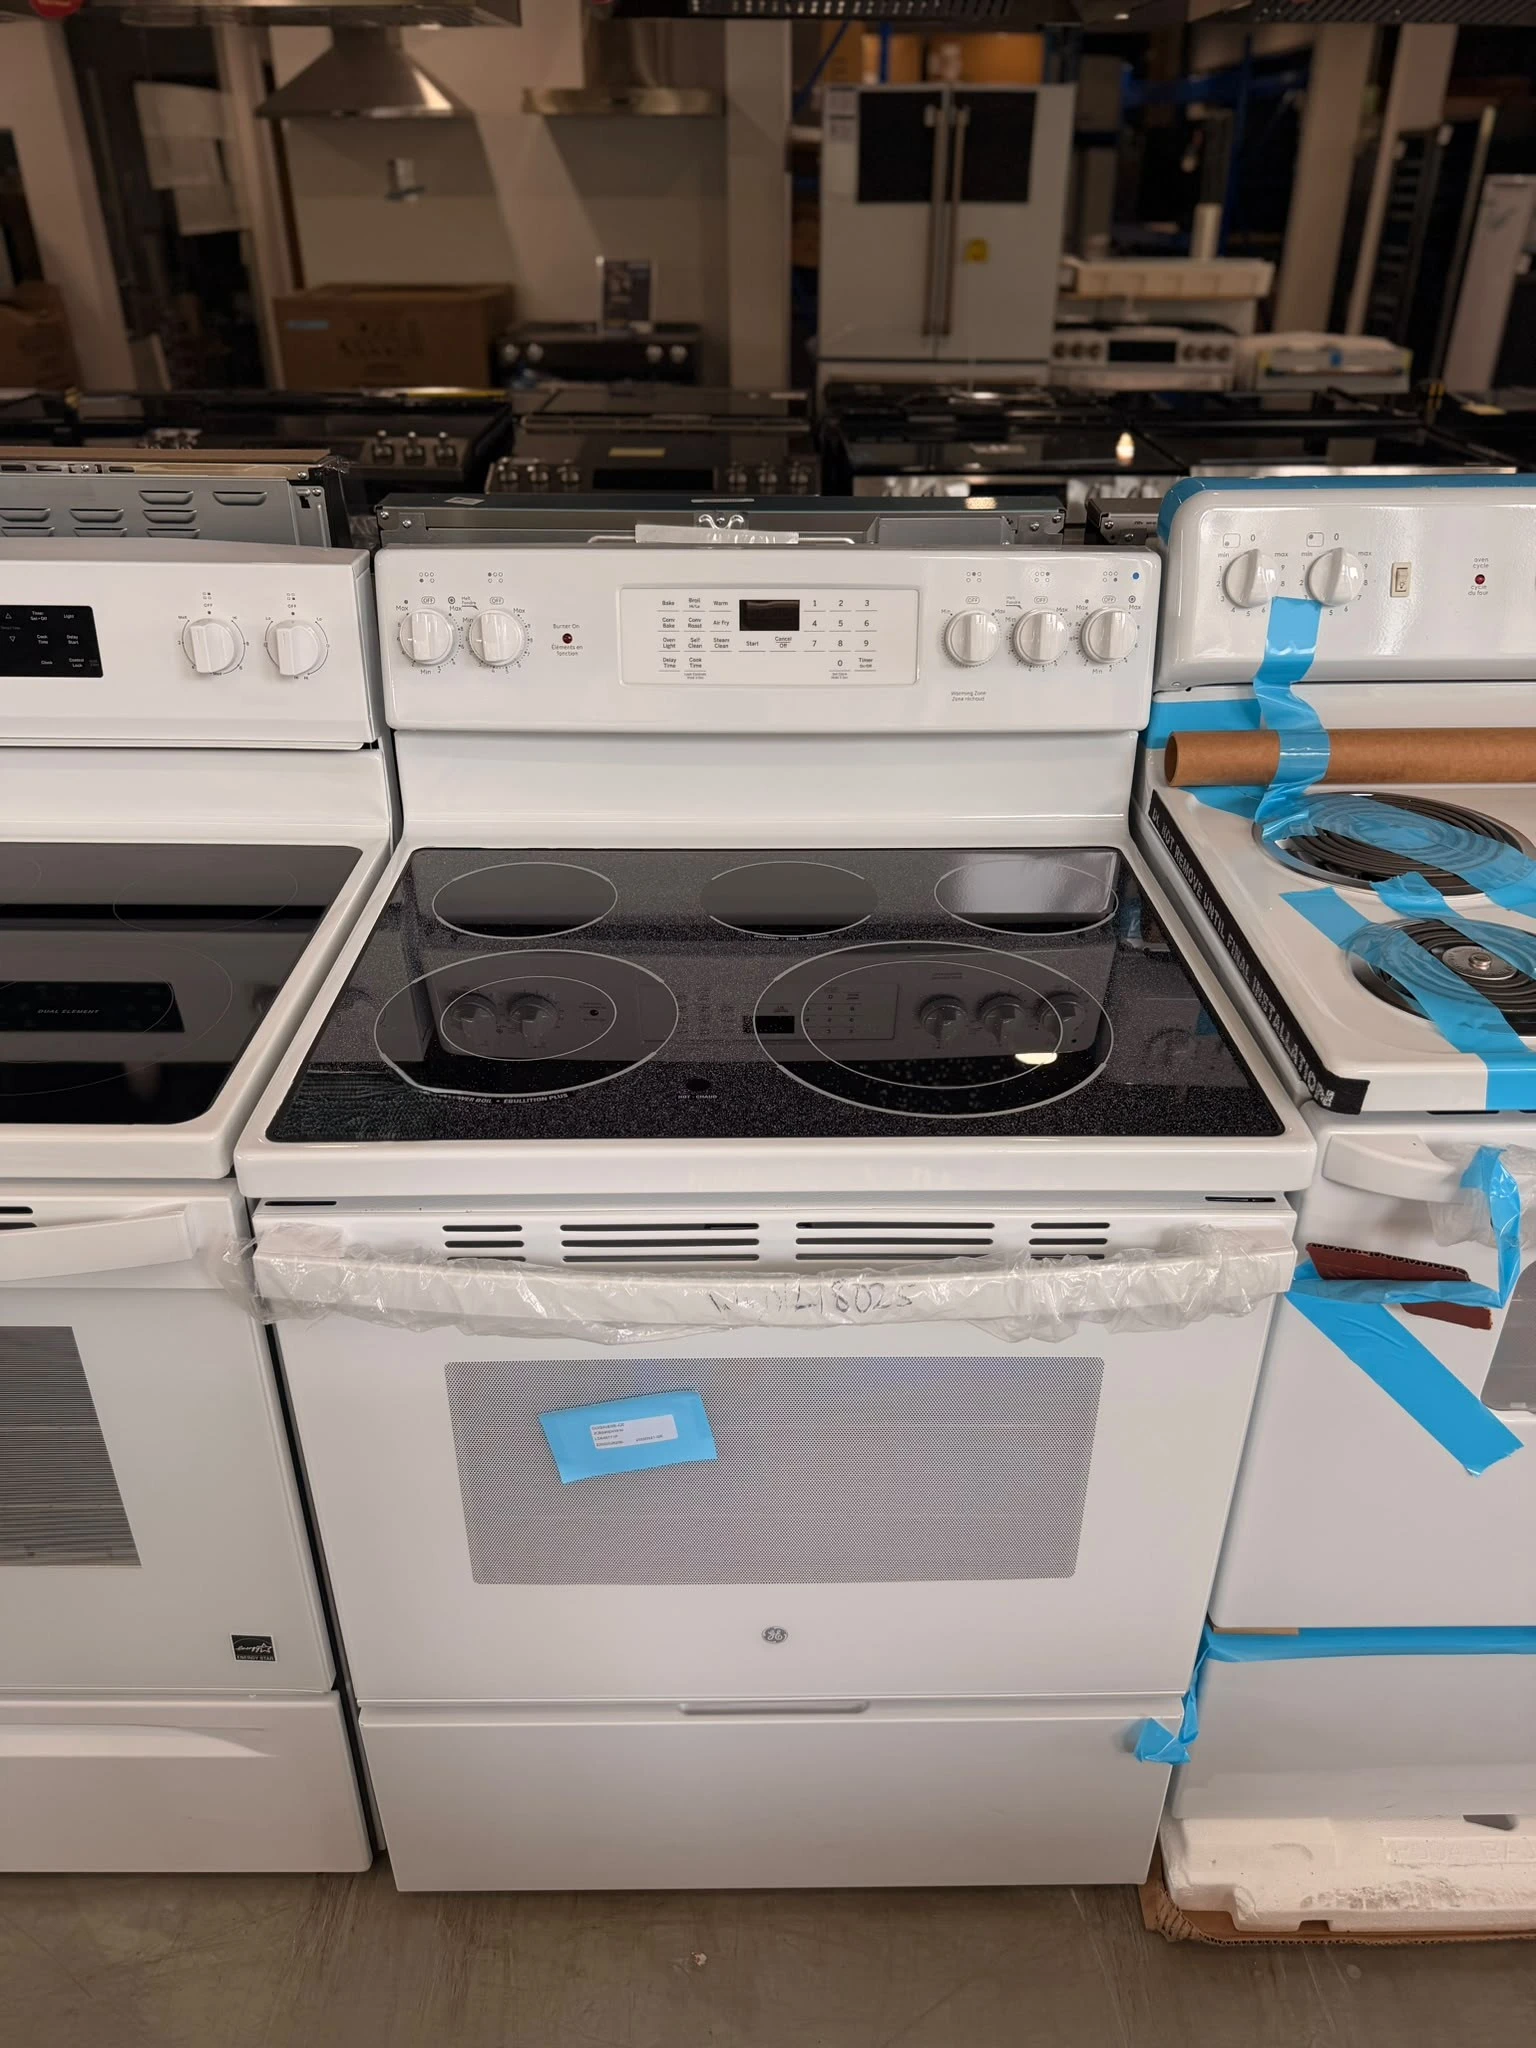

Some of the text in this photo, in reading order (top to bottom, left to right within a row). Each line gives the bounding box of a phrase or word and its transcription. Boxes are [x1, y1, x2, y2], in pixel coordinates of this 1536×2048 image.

[1250, 534, 1256, 542] 0
[1333, 533, 1339, 541] 0
[813, 599, 817, 607] 1
[839, 599, 844, 607] 2
[865, 599, 870, 607] 3
[1161, 822, 1175, 851] NOT
[1174, 844, 1204, 899] REMOVE
[1203, 891, 1225, 939] UNTIL
[1226, 932, 1250, 984] FINAL
[548, 1093, 569, 1101] PLUS
